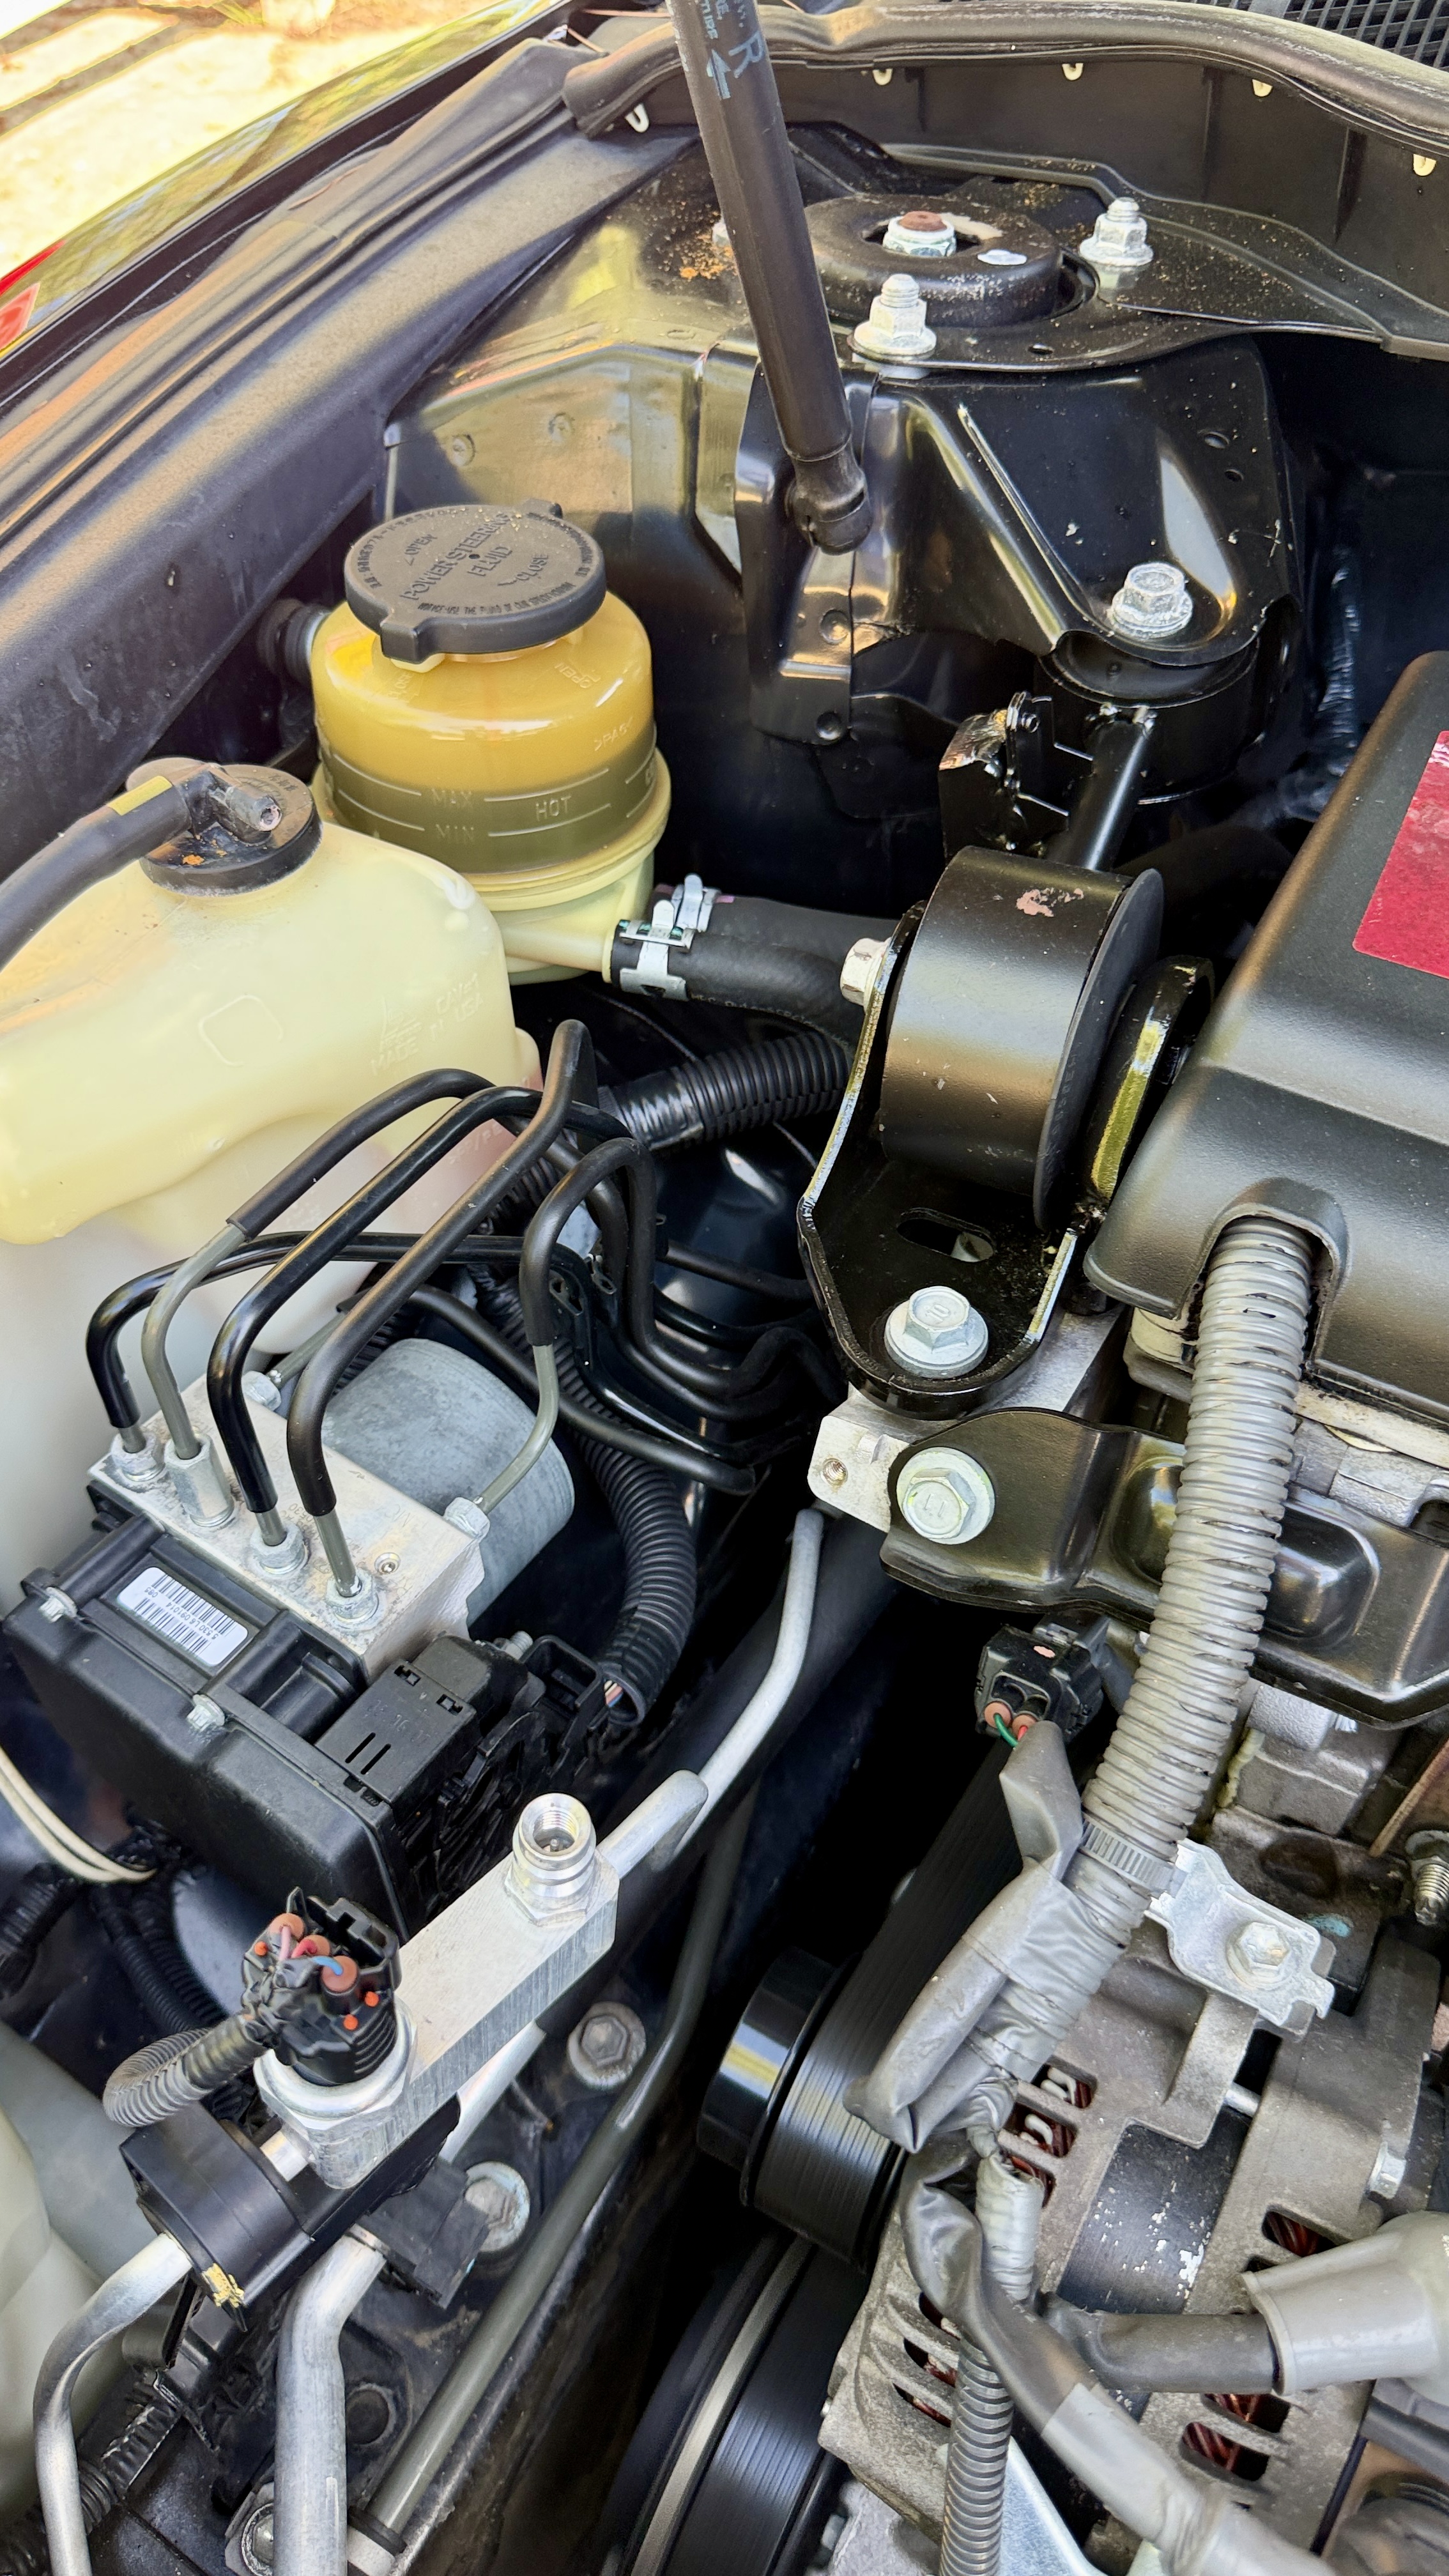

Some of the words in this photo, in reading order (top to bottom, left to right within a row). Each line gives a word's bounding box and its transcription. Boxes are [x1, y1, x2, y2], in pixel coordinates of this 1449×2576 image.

[399, 560, 456, 600] POWER
[446, 512, 512, 560] STEERING
[405, 533, 438, 555] OPEN
[467, 545, 512, 577] FLUID
[517, 553, 550, 582] CLOSE
[554, 662, 594, 689] OPEN
[432, 788, 473, 809] MAX
[535, 795, 572, 822] HOT
[436, 823, 474, 841] MIN
